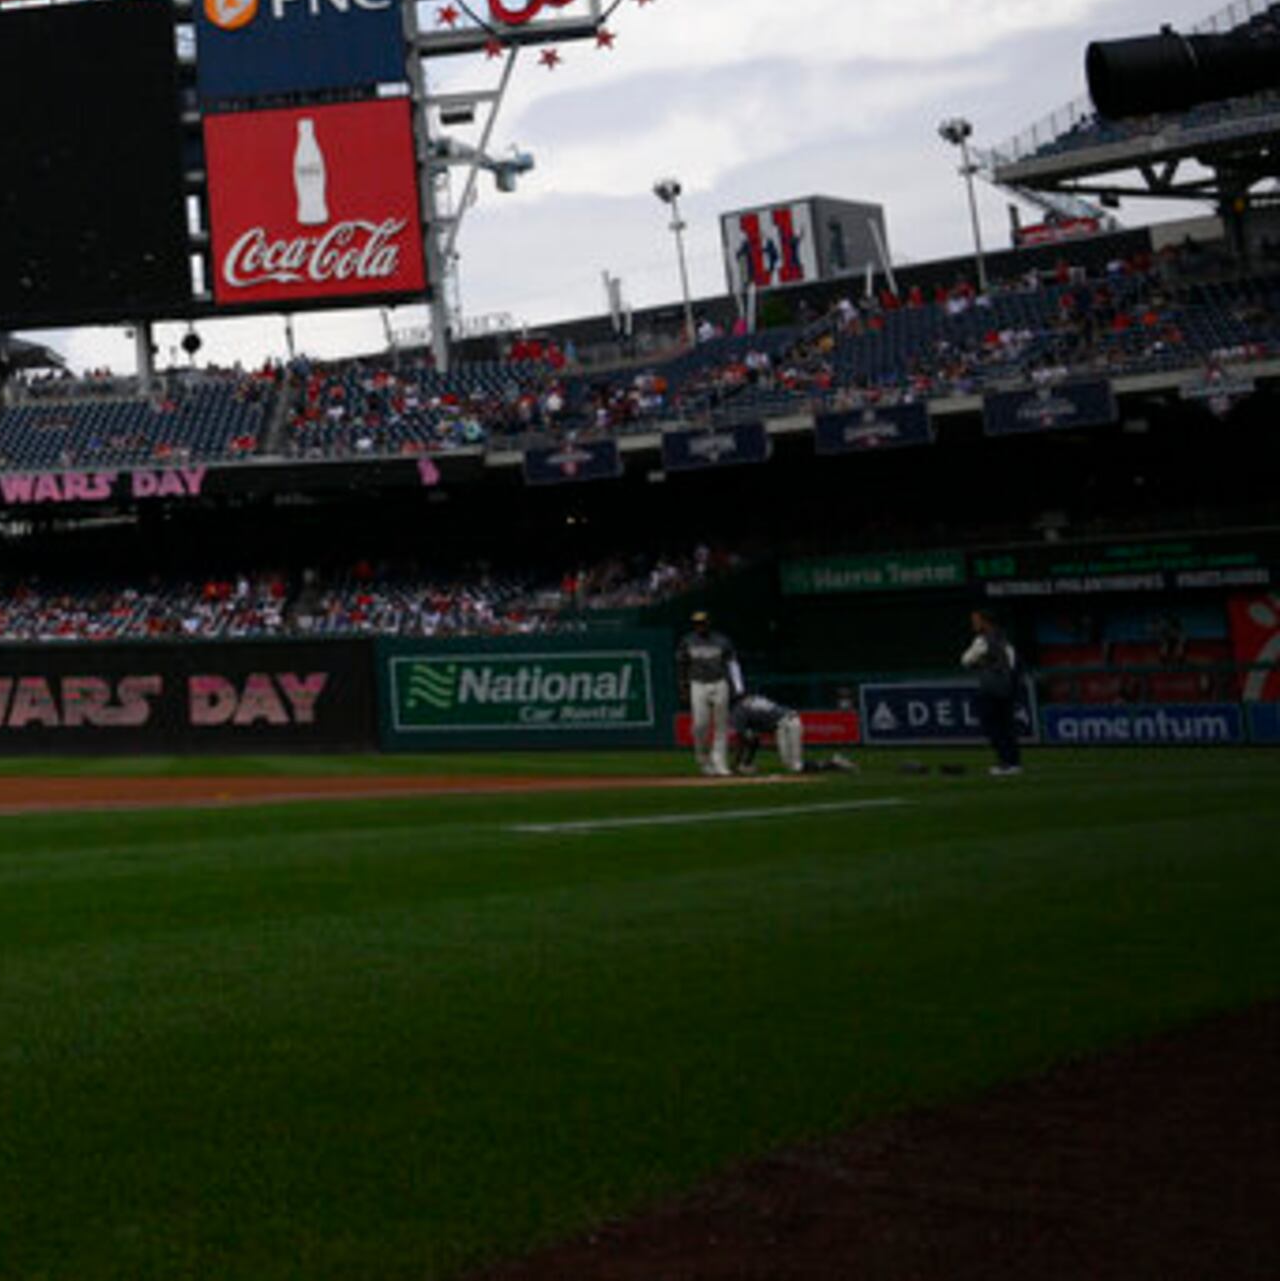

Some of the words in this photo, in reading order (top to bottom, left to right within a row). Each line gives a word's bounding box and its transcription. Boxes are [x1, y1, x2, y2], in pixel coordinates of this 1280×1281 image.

[223, 217, 408, 287] Coca-Cola
[131, 465, 208, 499] DAY
[188, 671, 329, 726] DAY
[458, 663, 633, 705] National
[1057, 708, 1232, 741] amentum
